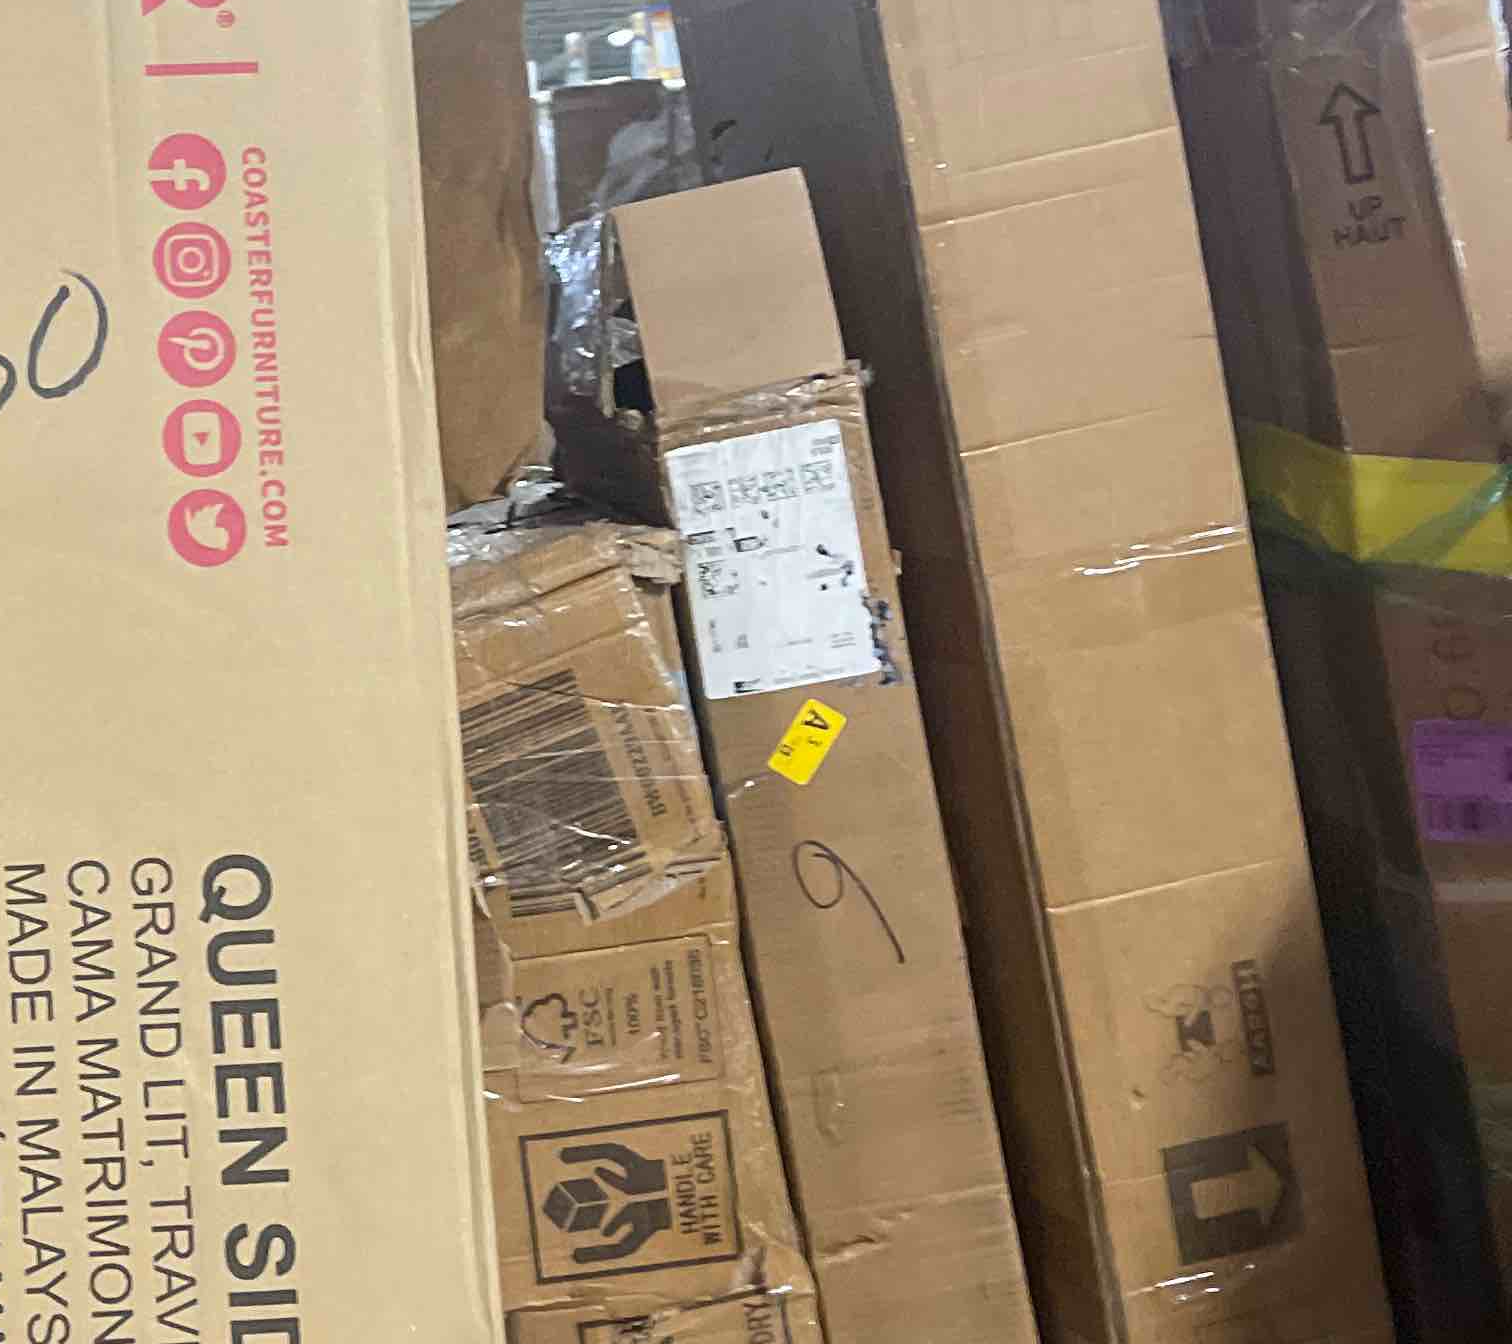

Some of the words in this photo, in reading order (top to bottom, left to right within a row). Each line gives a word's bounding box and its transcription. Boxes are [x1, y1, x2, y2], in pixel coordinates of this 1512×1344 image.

[242, 147, 288, 546] COASTERFURNITURE.COM
[3, 864, 55, 1024] MADE
[67, 860, 116, 1022] CAMA
[131, 858, 182, 1058] GRAND
[13, 1046, 58, 1096] IN
[198, 854, 290, 1185] QUEEN
[139, 1080, 189, 1166] LIT,
[694, 1131, 717, 1184] CARE
[672, 1152, 700, 1236] HANDLE
[699, 1194, 725, 1247] WITH
